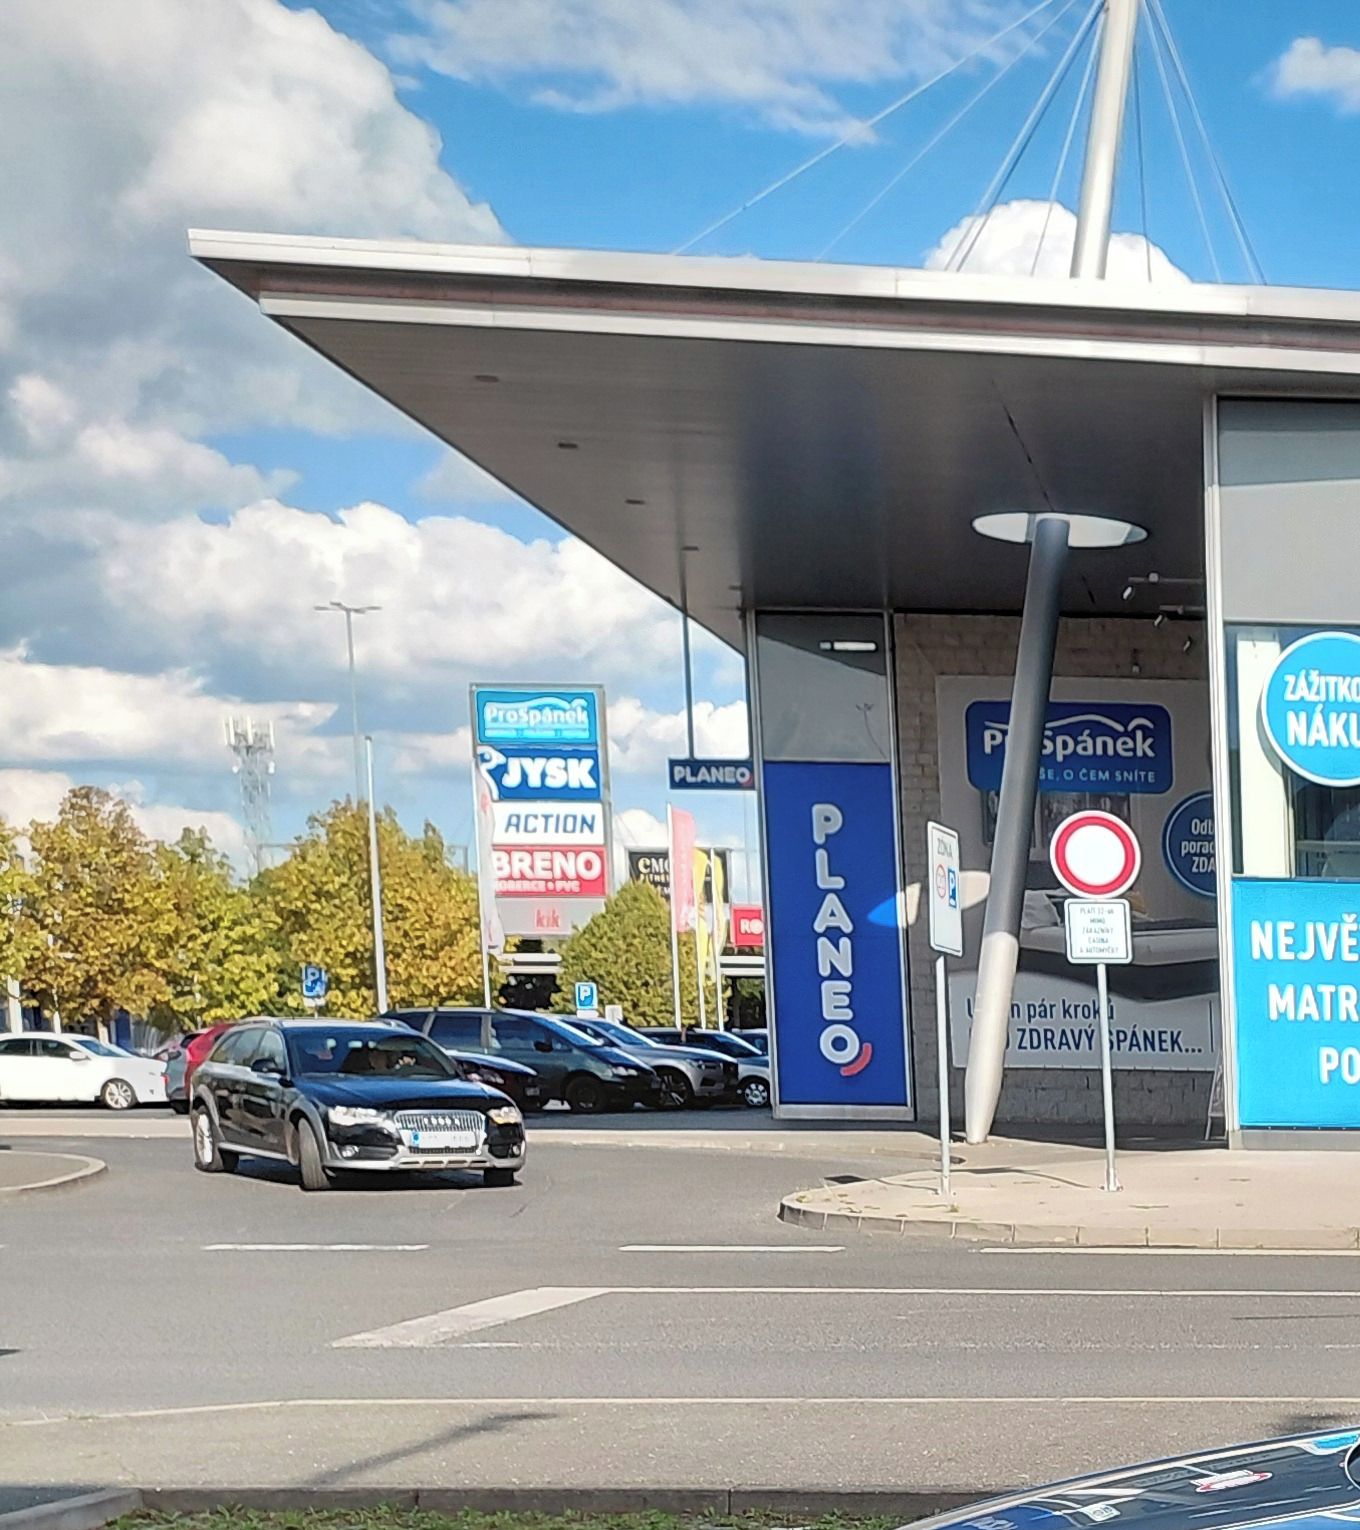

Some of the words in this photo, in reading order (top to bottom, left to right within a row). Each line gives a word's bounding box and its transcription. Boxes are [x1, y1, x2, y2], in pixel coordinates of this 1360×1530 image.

[984, 728, 1155, 762] PSpánek
[501, 757, 597, 788] JYSK
[673, 765, 751, 784] PLANEO
[1039, 766, 1059, 782] ŠE,
[1064, 768, 1074, 781] O
[1081, 767, 1110, 782] ČEM
[1115, 768, 1156, 783] SNÍTE
[505, 814, 596, 834] ACTION
[492, 850, 602, 881] BRENO
[811, 803, 861, 1064] PLANEO
[1027, 999, 1054, 1023] pár
[1016, 1022, 1096, 1051] ZDRAVÝ
